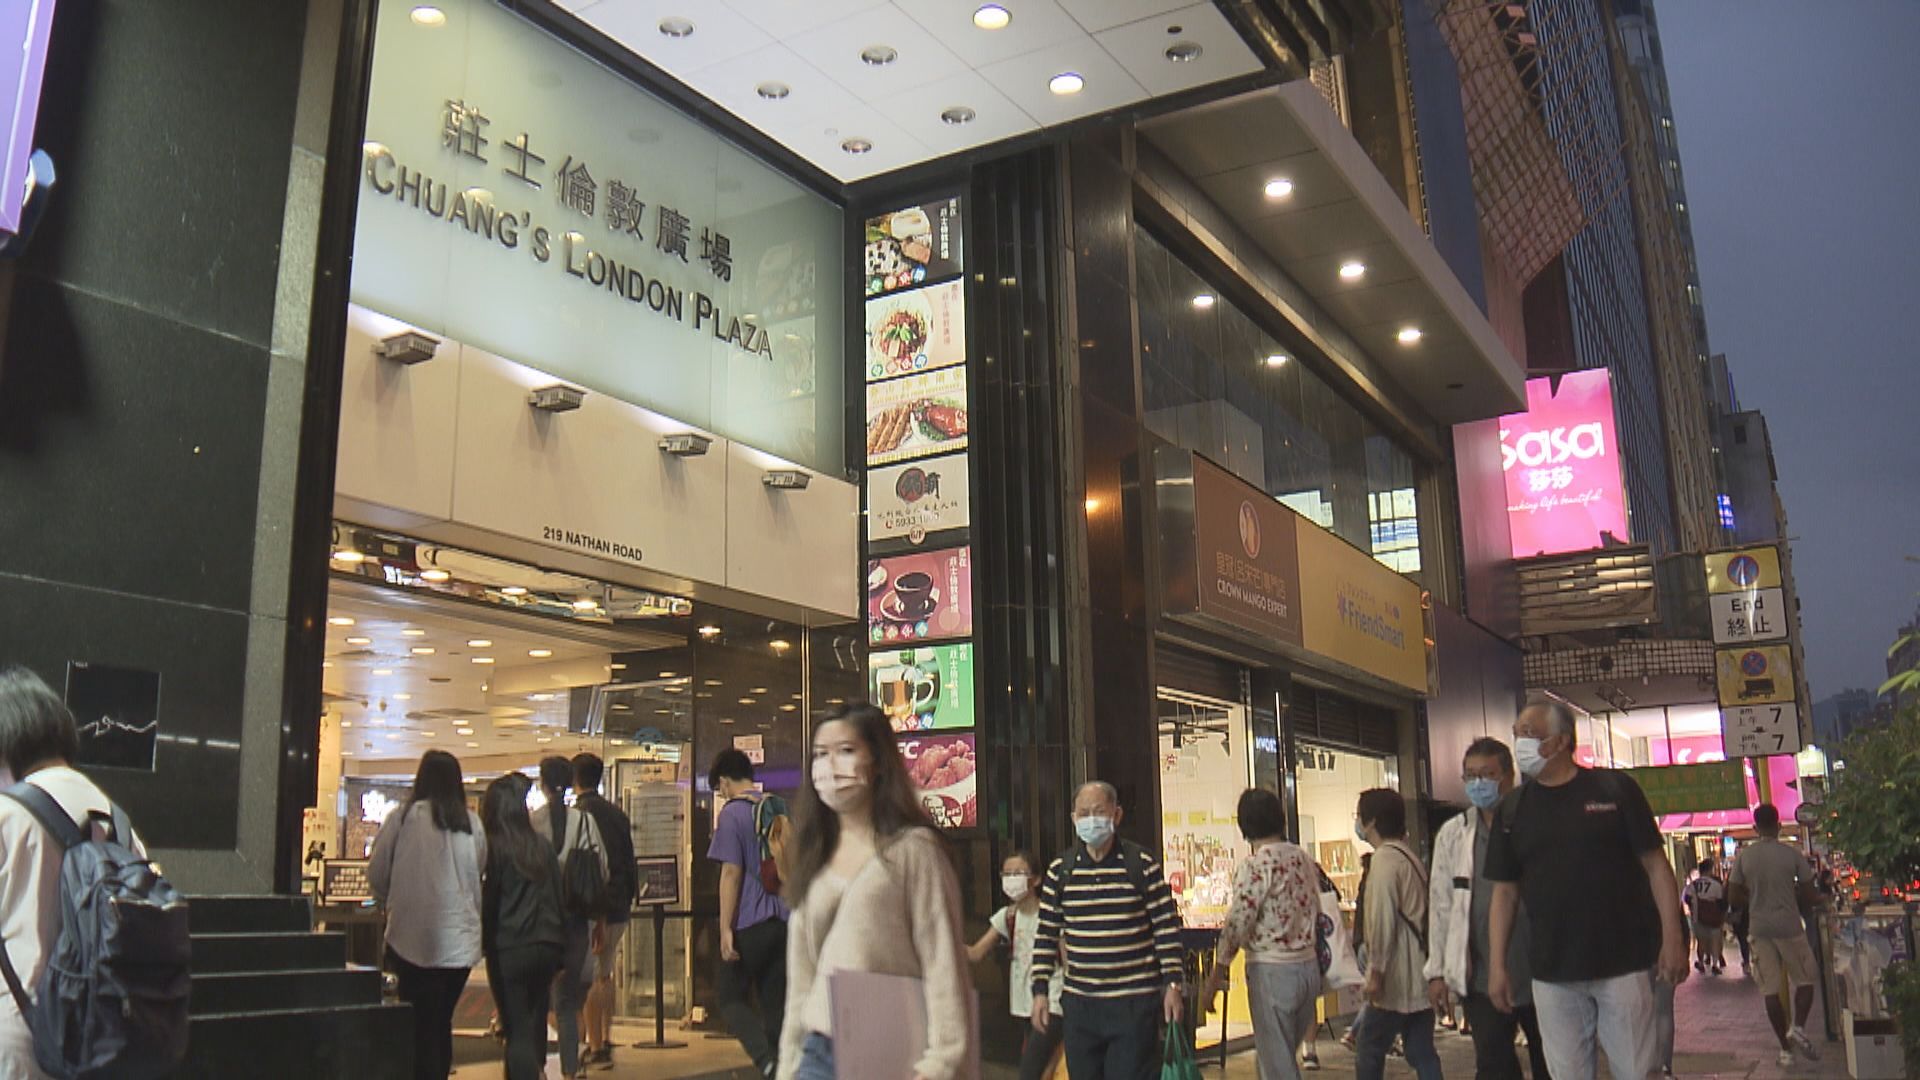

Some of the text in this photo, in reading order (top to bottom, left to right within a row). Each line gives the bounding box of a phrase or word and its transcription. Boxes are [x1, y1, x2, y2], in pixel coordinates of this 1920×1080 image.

[443, 99, 733, 282] 莊士倫敦廣場
[543, 526, 643, 561] 219 NATHAN ROAD
[1731, 596, 1764, 612] End
[1727, 614, 1772, 637] 終止
[1769, 706, 1782, 724] 7
[1771, 734, 1784, 751] 7
